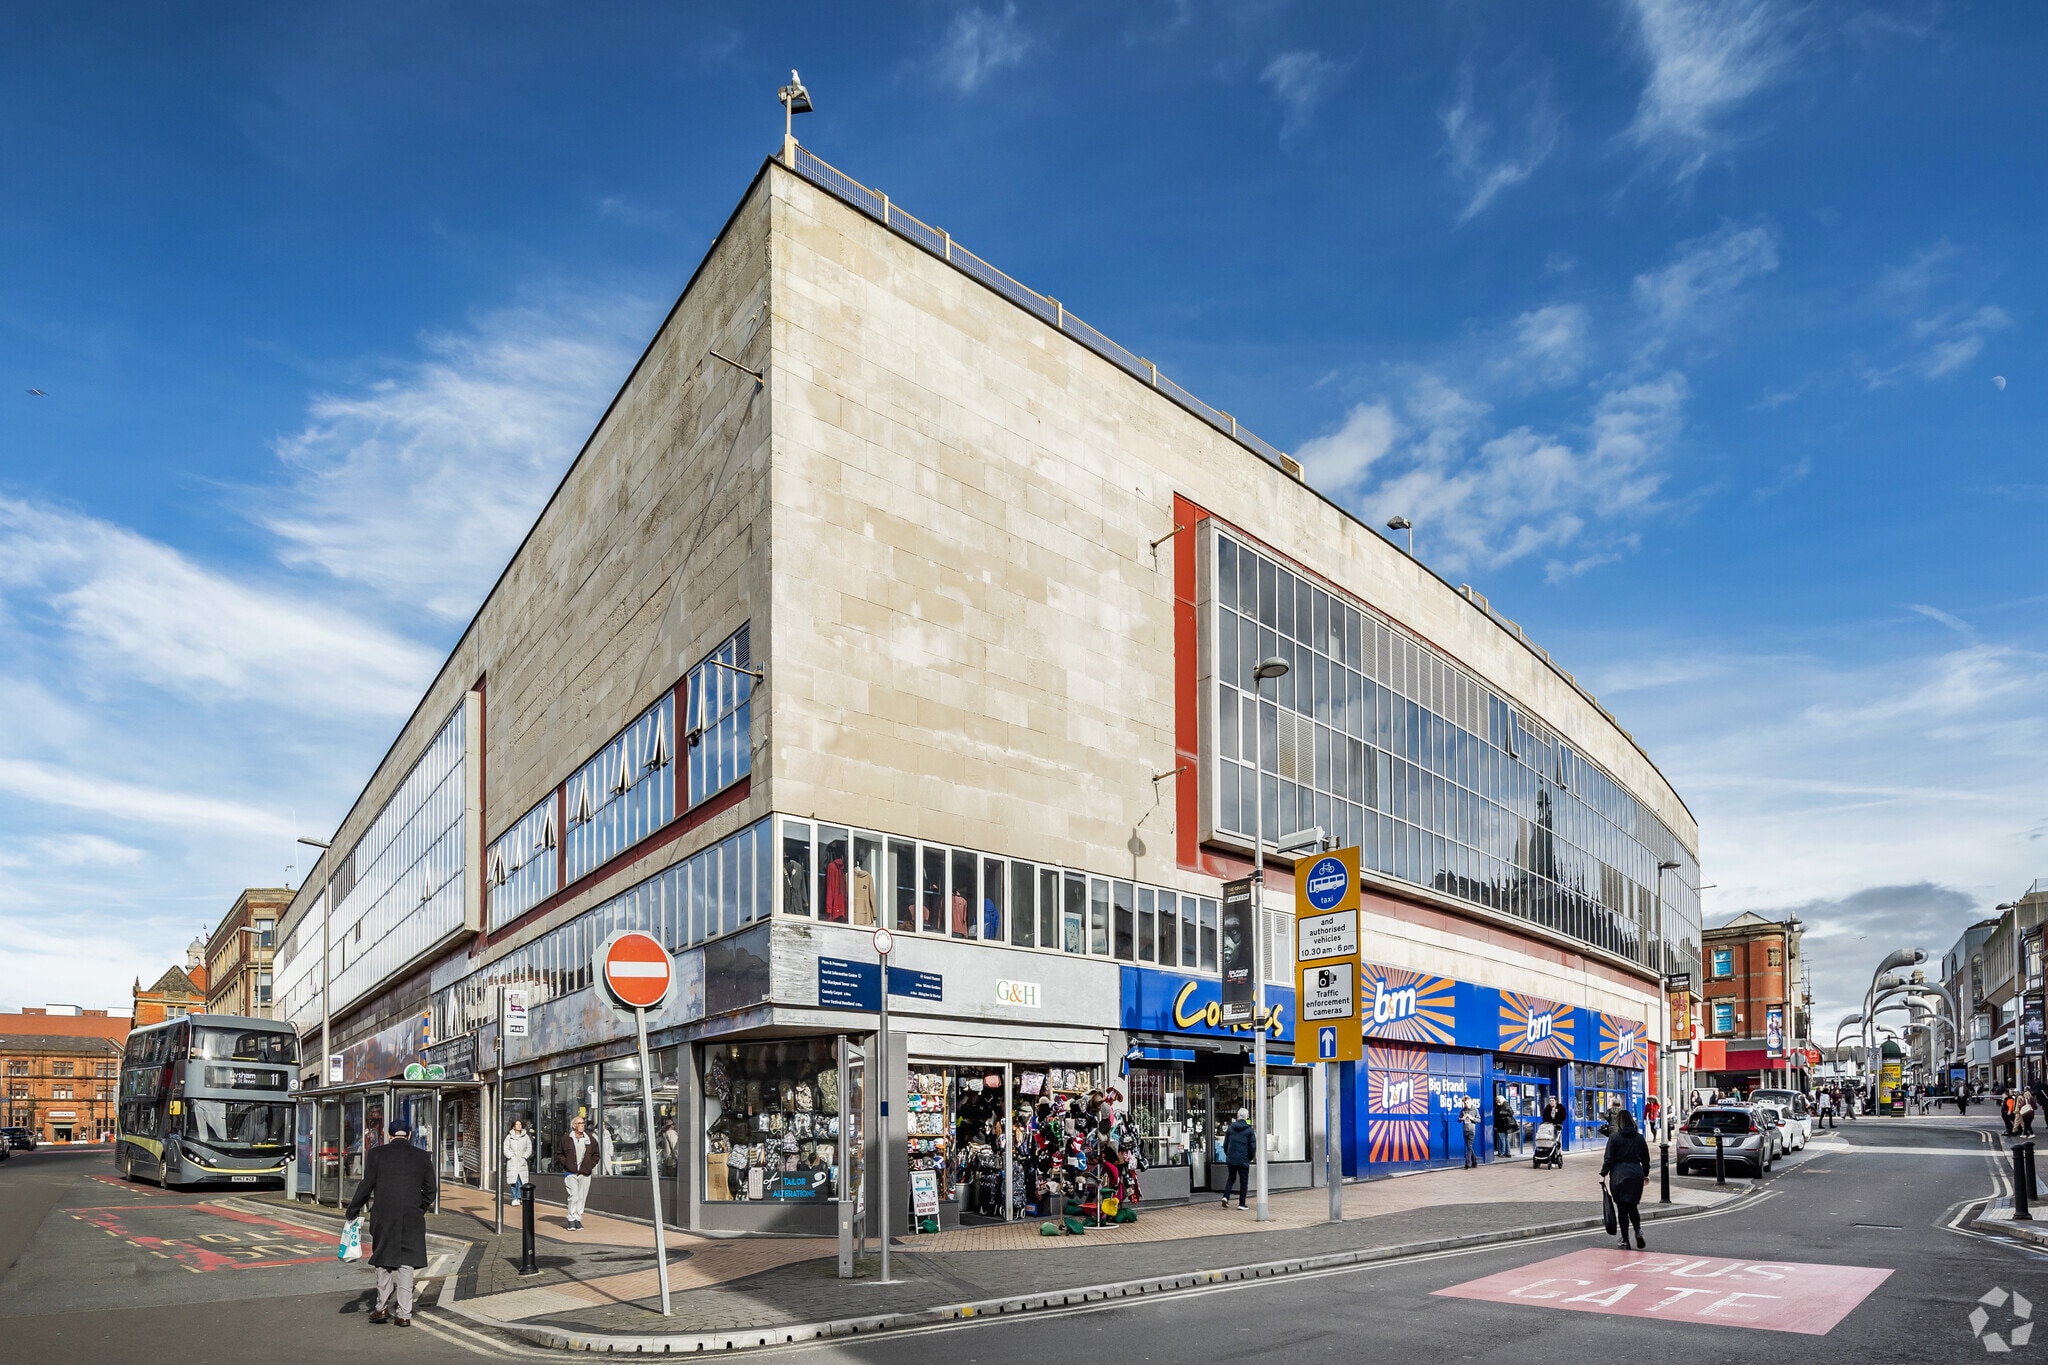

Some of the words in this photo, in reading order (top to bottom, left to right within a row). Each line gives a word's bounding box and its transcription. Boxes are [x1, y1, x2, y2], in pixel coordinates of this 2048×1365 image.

[1321, 895, 1334, 904] taxi
[1321, 917, 1334, 926] and
[1309, 924, 1346, 936] authorised
[1313, 934, 1342, 944] vehicles
[1301, 947, 1321, 957] 10.30
[1322, 946, 1333, 954] am
[1343, 943, 1355, 953] pm
[996, 980, 1037, 1005] G&H
[1316, 989, 1339, 998] Traffic
[1306, 997, 1350, 1009] enforcement
[1313, 1006, 1343, 1016] cameras
[270, 1073, 279, 1085] 11
[1428, 1078, 1441, 1095] Big
[1442, 1079, 1467, 1092] Brands
[1440, 1094, 1453, 1111] Big
[783, 1178, 807, 1186] TAILOR
[772, 1189, 816, 1198] ALTERATIONS
[1609, 1255, 1797, 1281] BUS
[1507, 1277, 1783, 1320] GATE
